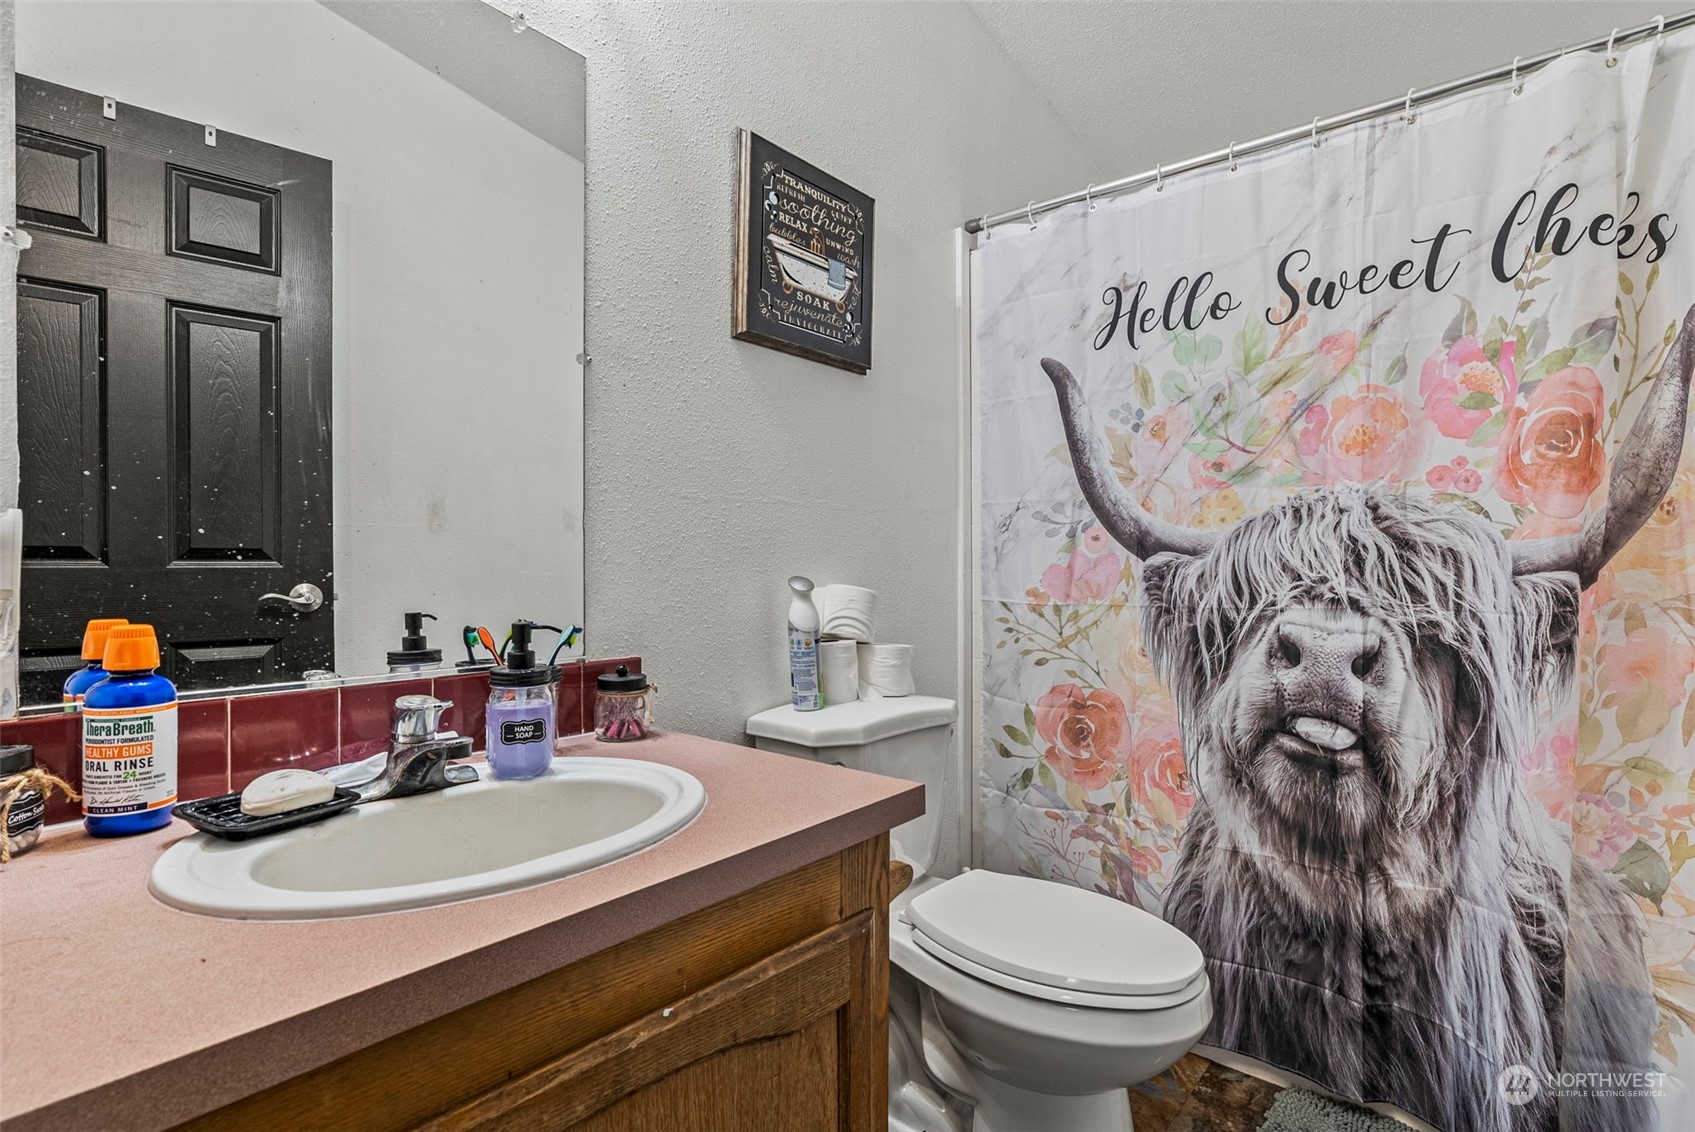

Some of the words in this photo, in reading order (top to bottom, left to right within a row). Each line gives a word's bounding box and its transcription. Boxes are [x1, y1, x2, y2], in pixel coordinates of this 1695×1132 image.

[783, 174, 847, 213] TRANQUILITY
[778, 211, 808, 233] RELAX
[779, 198, 856, 246] soothing
[769, 222, 806, 246] bubbles
[825, 237, 854, 256] UNWIND
[762, 245, 780, 285] calm
[1093, 271, 1241, 351] Hello
[1266, 222, 1472, 326] Sweet
[796, 291, 830, 311] SOAK
[774, 296, 844, 328] rejuvenate
[514, 724, 534, 732] HAND
[116, 735, 154, 744] FORMULATED
[122, 744, 152, 756] GUMS
[86, 760, 108, 772] ORAL
[114, 757, 154, 772] RINSE
[122, 770, 137, 780] 24
[8, 812, 33, 824] Cotton
